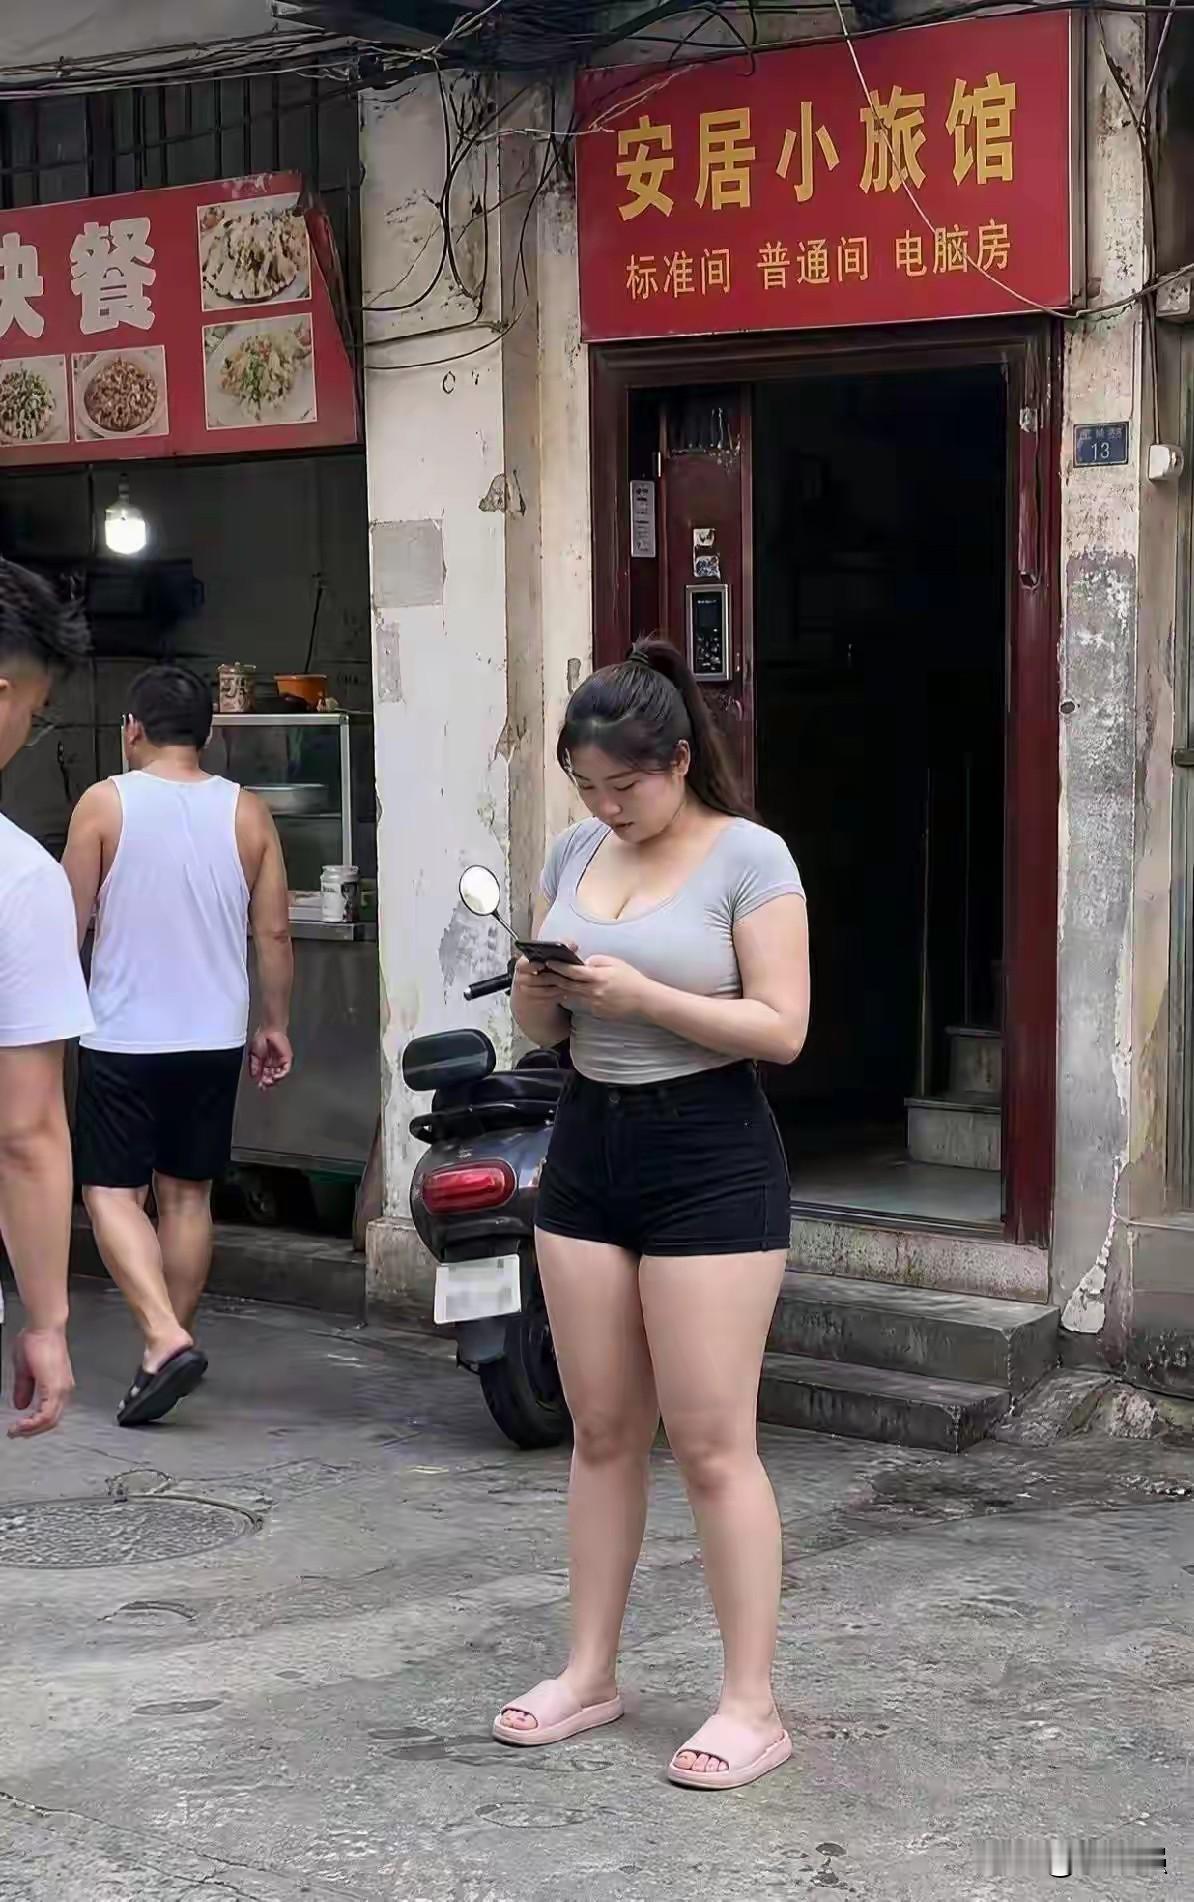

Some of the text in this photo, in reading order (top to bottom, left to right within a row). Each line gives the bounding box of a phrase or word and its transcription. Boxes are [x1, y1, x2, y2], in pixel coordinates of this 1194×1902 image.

[616, 73, 1016, 222] 安居小旅馆
[626, 218, 1011, 300] 标准间 普通间 电脑房
[1091, 442, 1110, 461] 13
